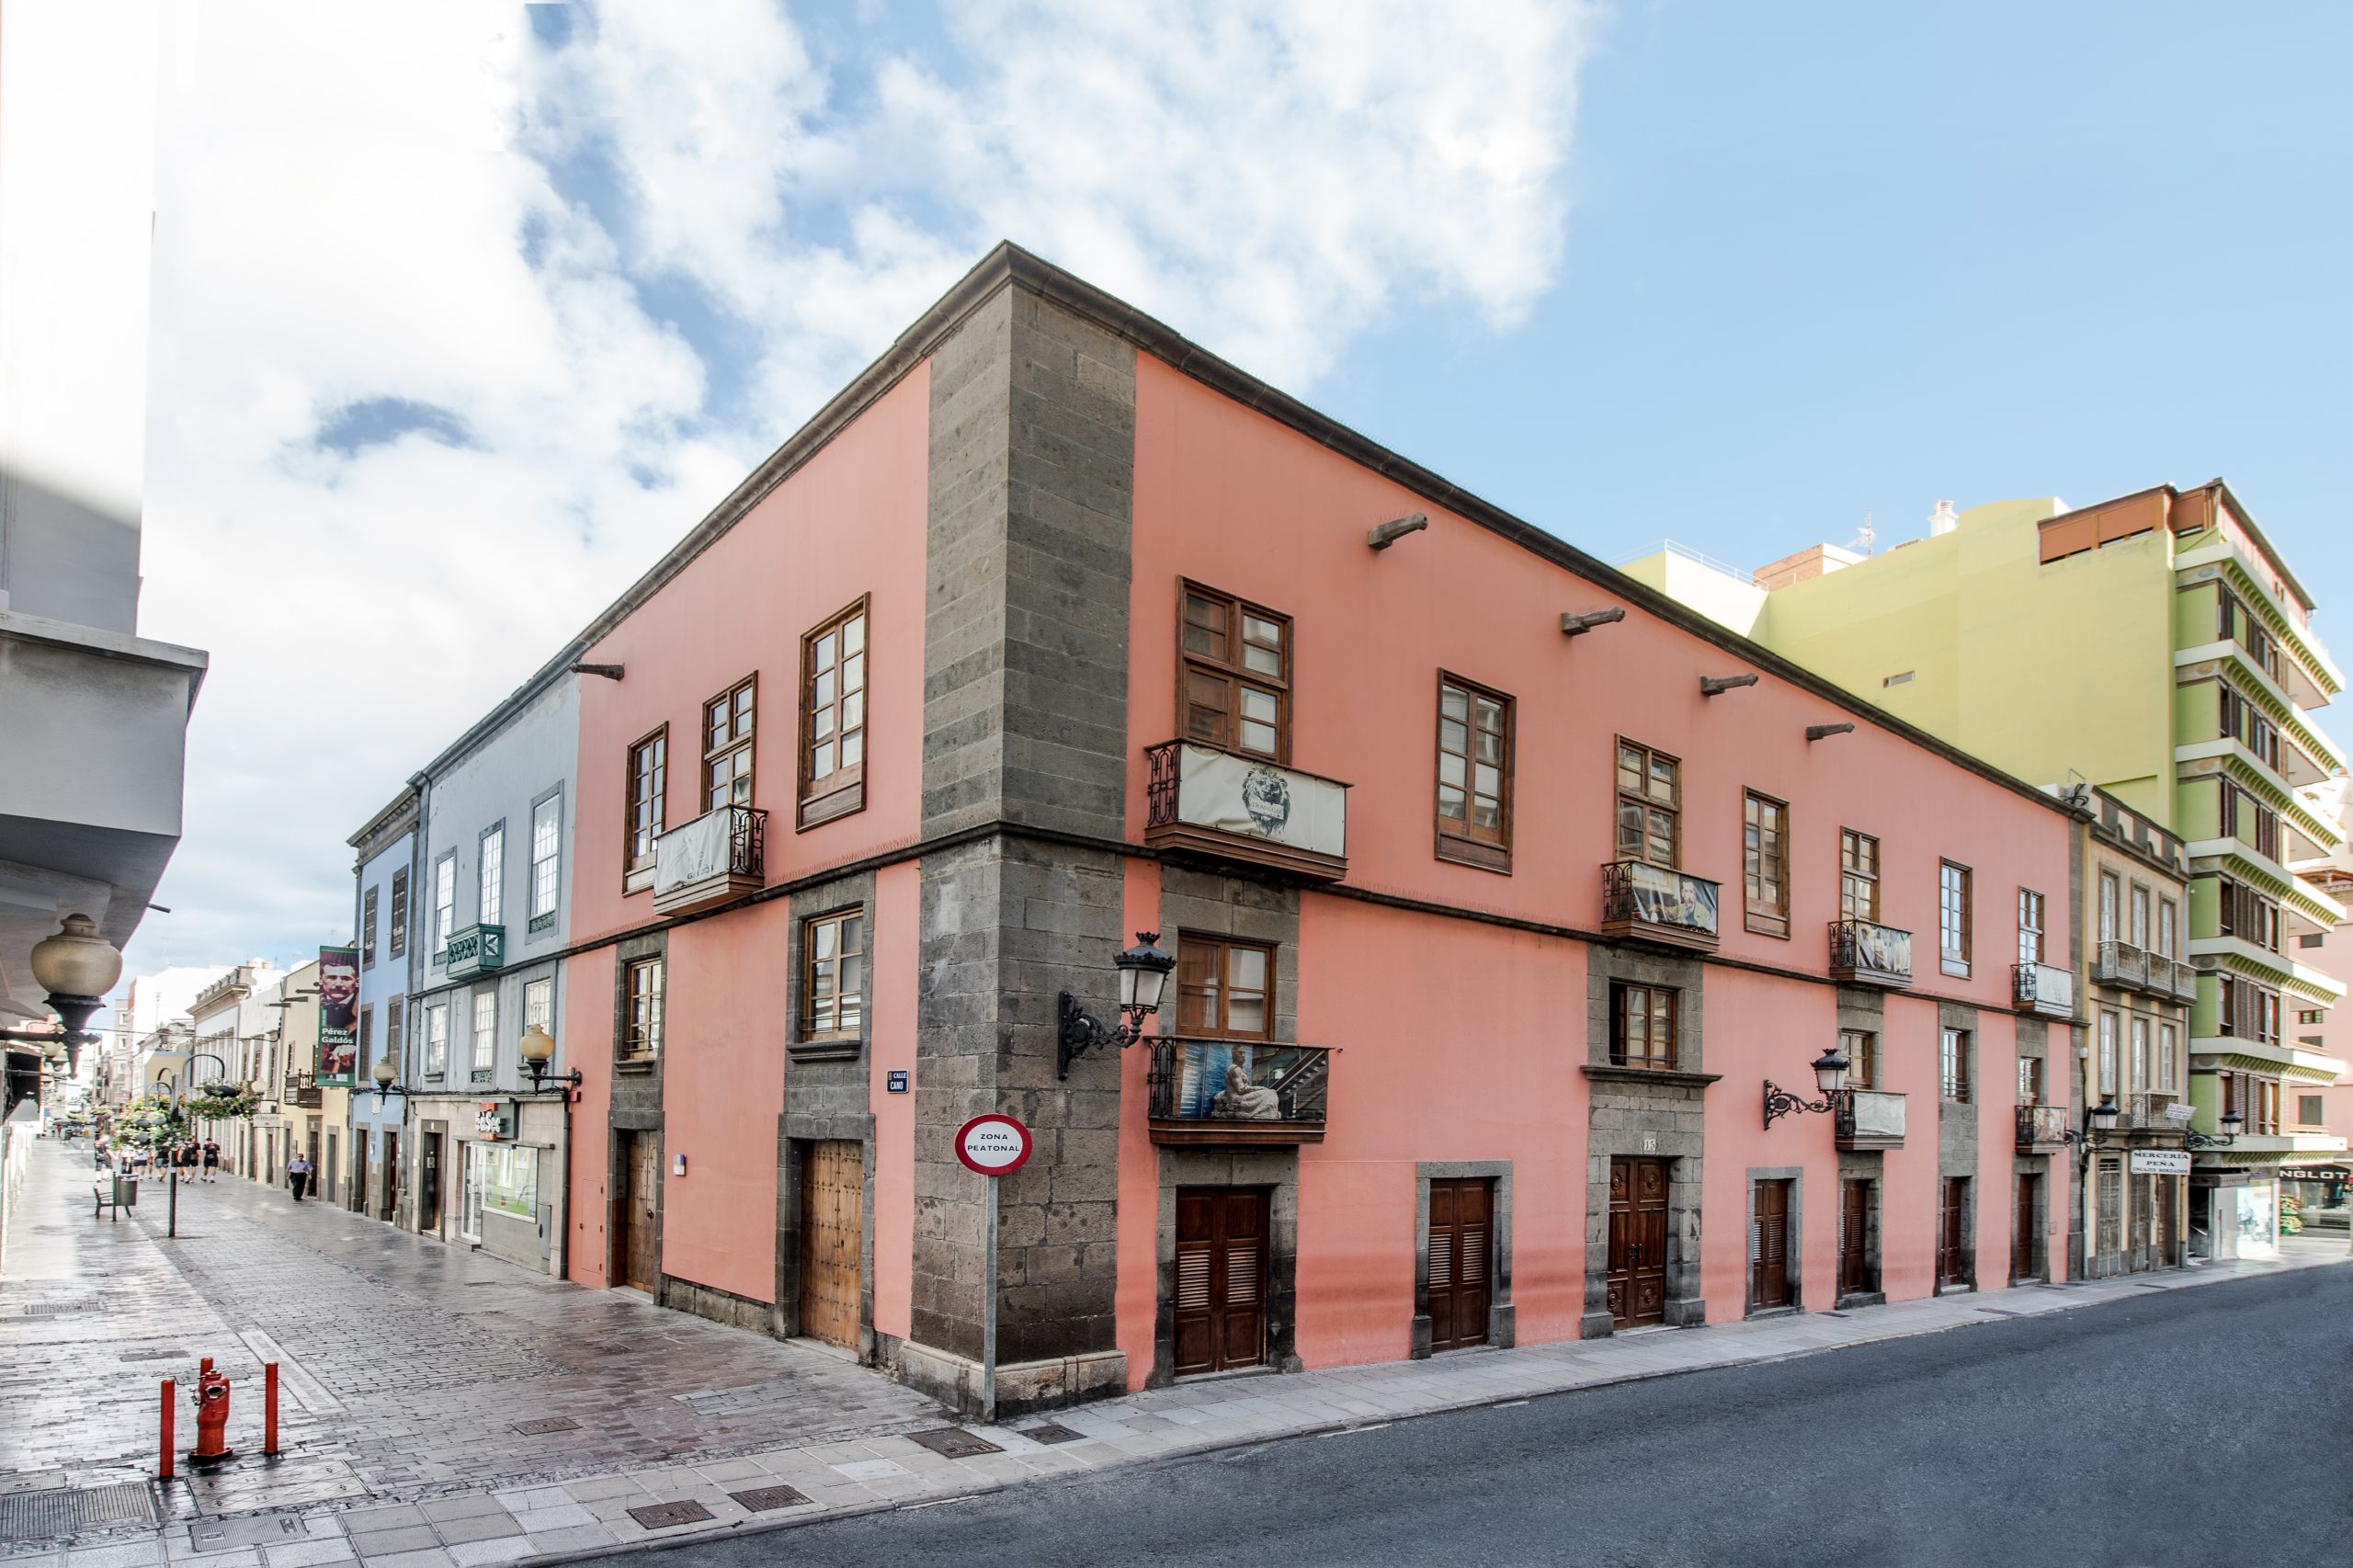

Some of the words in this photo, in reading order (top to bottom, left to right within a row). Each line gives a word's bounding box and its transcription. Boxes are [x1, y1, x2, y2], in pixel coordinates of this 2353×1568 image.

[322, 1028, 347, 1036] Pérez
[322, 1036, 354, 1044] Galdós
[890, 1081, 904, 1090] CANO
[2146, 1159, 2176, 1167] PEÑA
